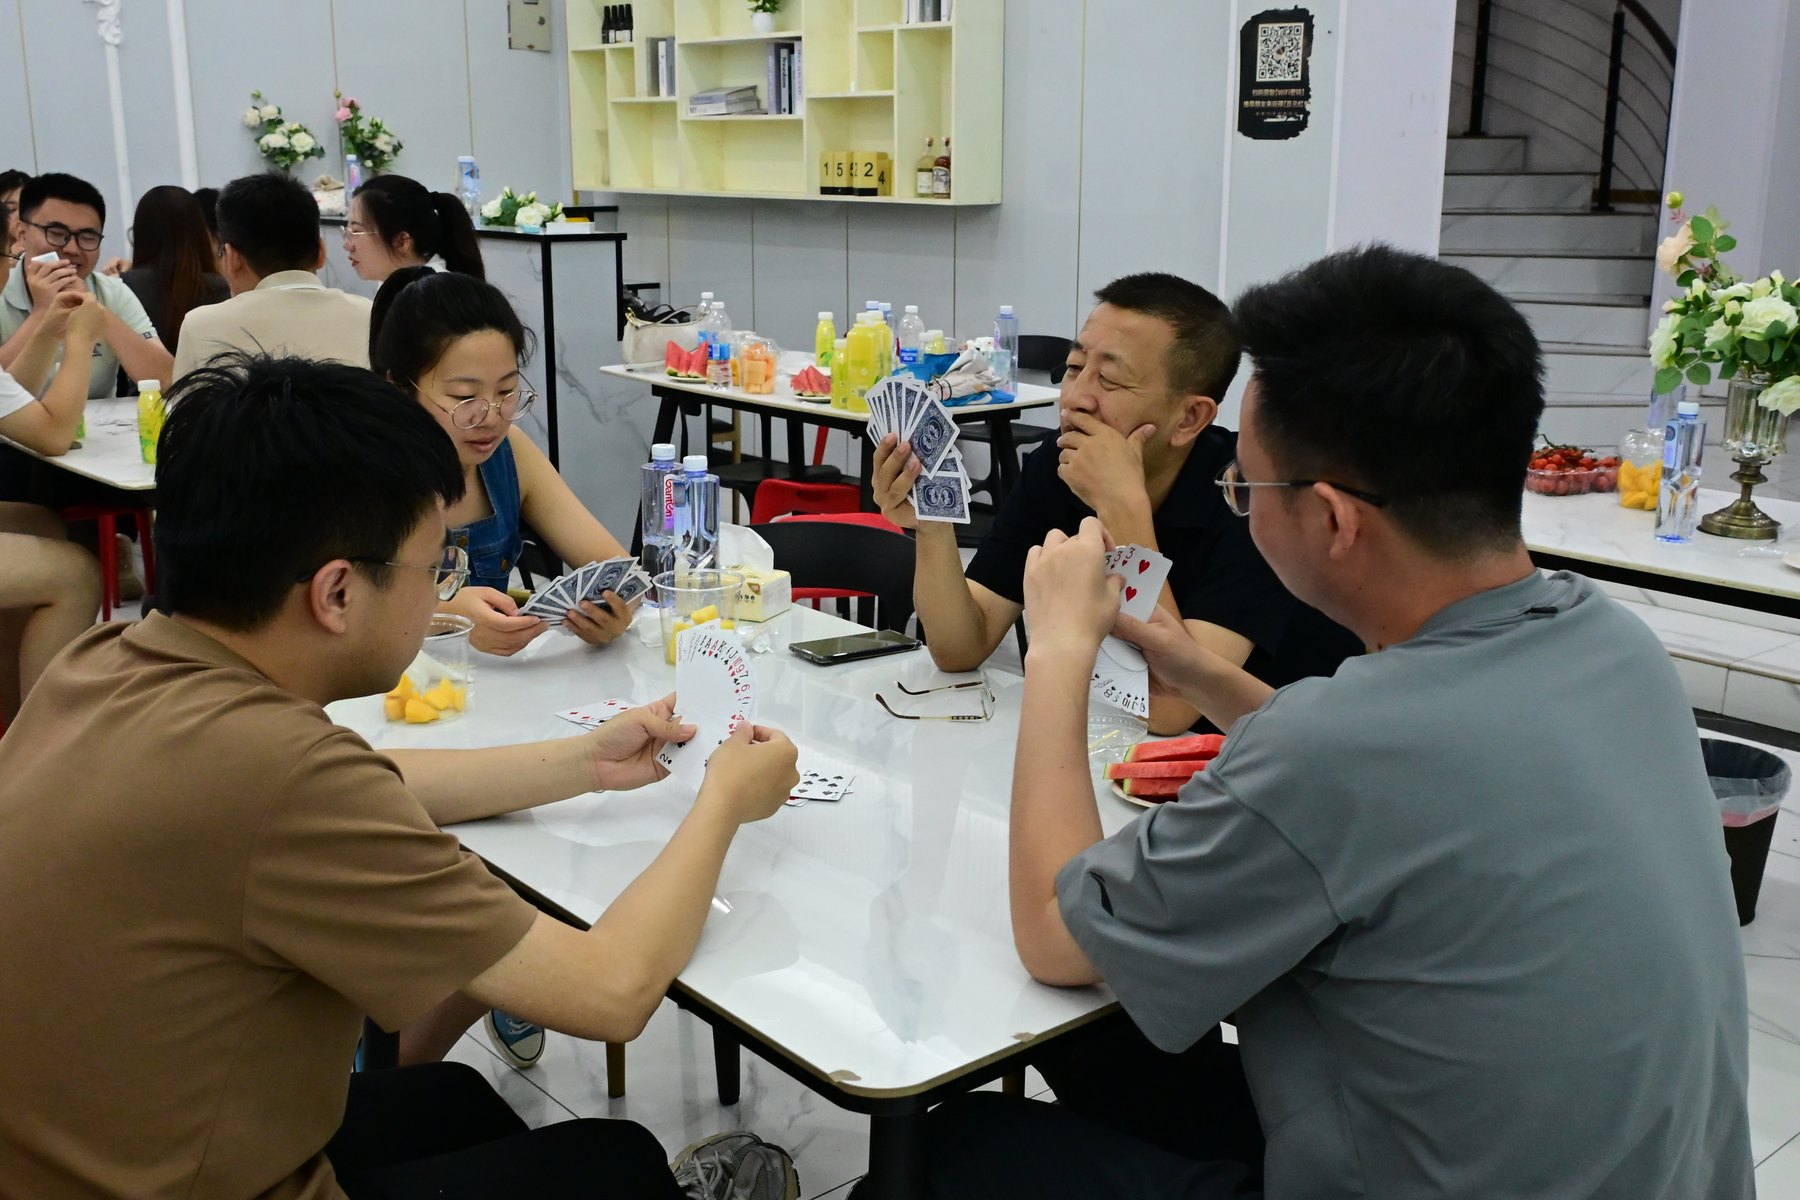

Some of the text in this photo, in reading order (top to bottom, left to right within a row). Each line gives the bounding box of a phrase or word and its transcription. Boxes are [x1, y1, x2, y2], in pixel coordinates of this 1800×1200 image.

[864, 162, 874, 177] 2
[878, 170, 886, 184] 4
[1113, 550, 1124, 562] 3
[1125, 546, 1136, 560] 3
[710, 639, 720, 651] A
[659, 753, 669, 763] 2
